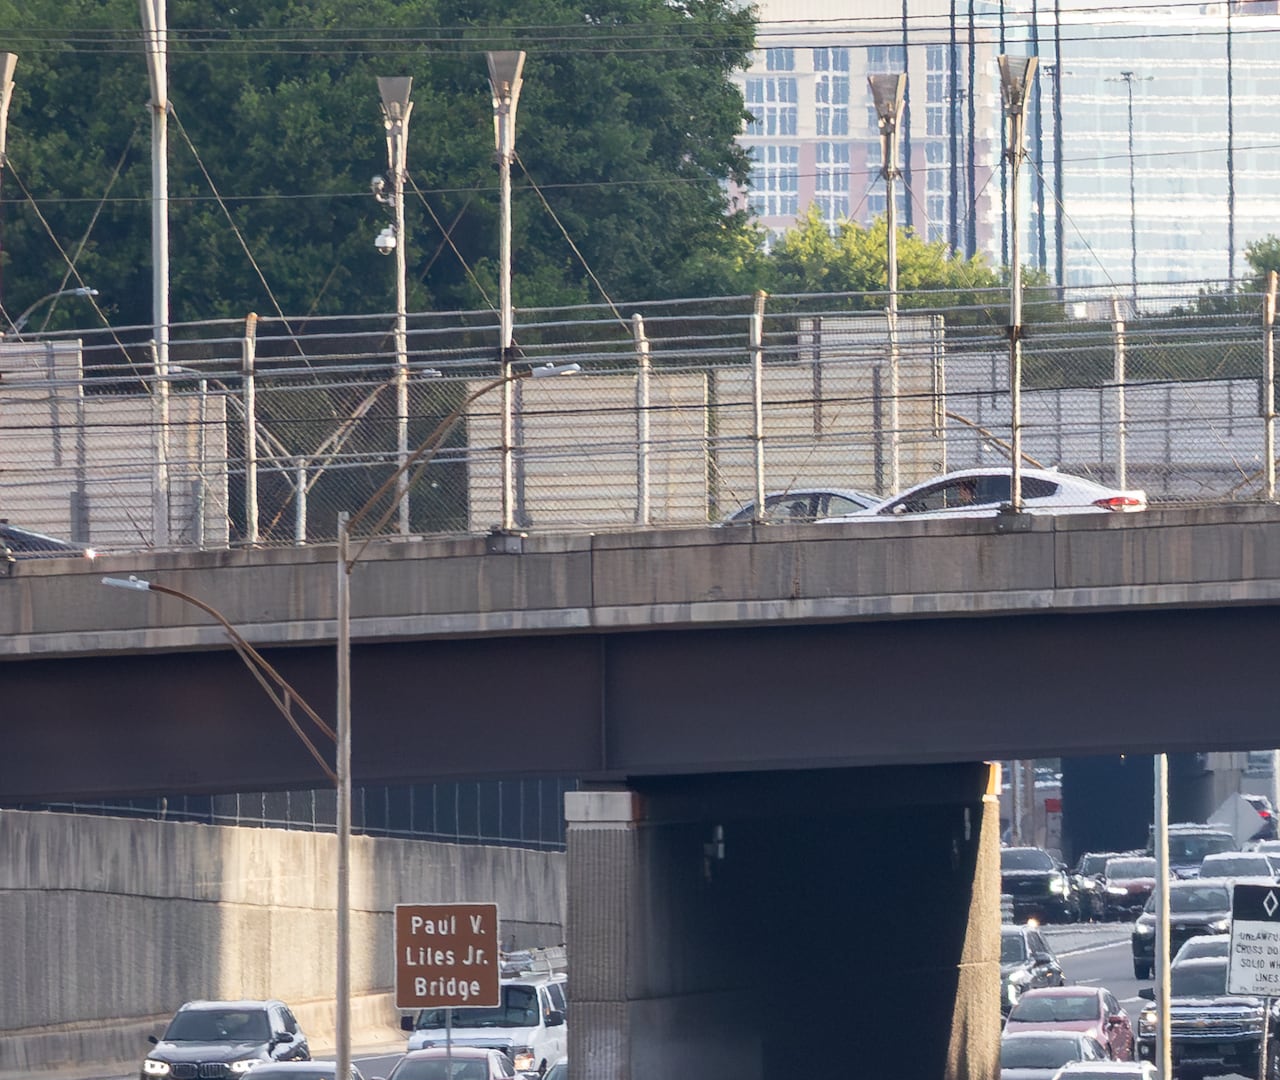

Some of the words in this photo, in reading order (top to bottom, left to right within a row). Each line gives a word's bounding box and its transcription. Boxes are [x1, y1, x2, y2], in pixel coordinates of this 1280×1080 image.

[411, 916, 456, 935] Paul
[470, 915, 486, 935] V.
[406, 946, 456, 966] Liles
[463, 945, 489, 965] Jr.
[1241, 959, 1265, 969] SOLID
[1255, 974, 1280, 983] LINES
[415, 977, 481, 1001] Bridge
